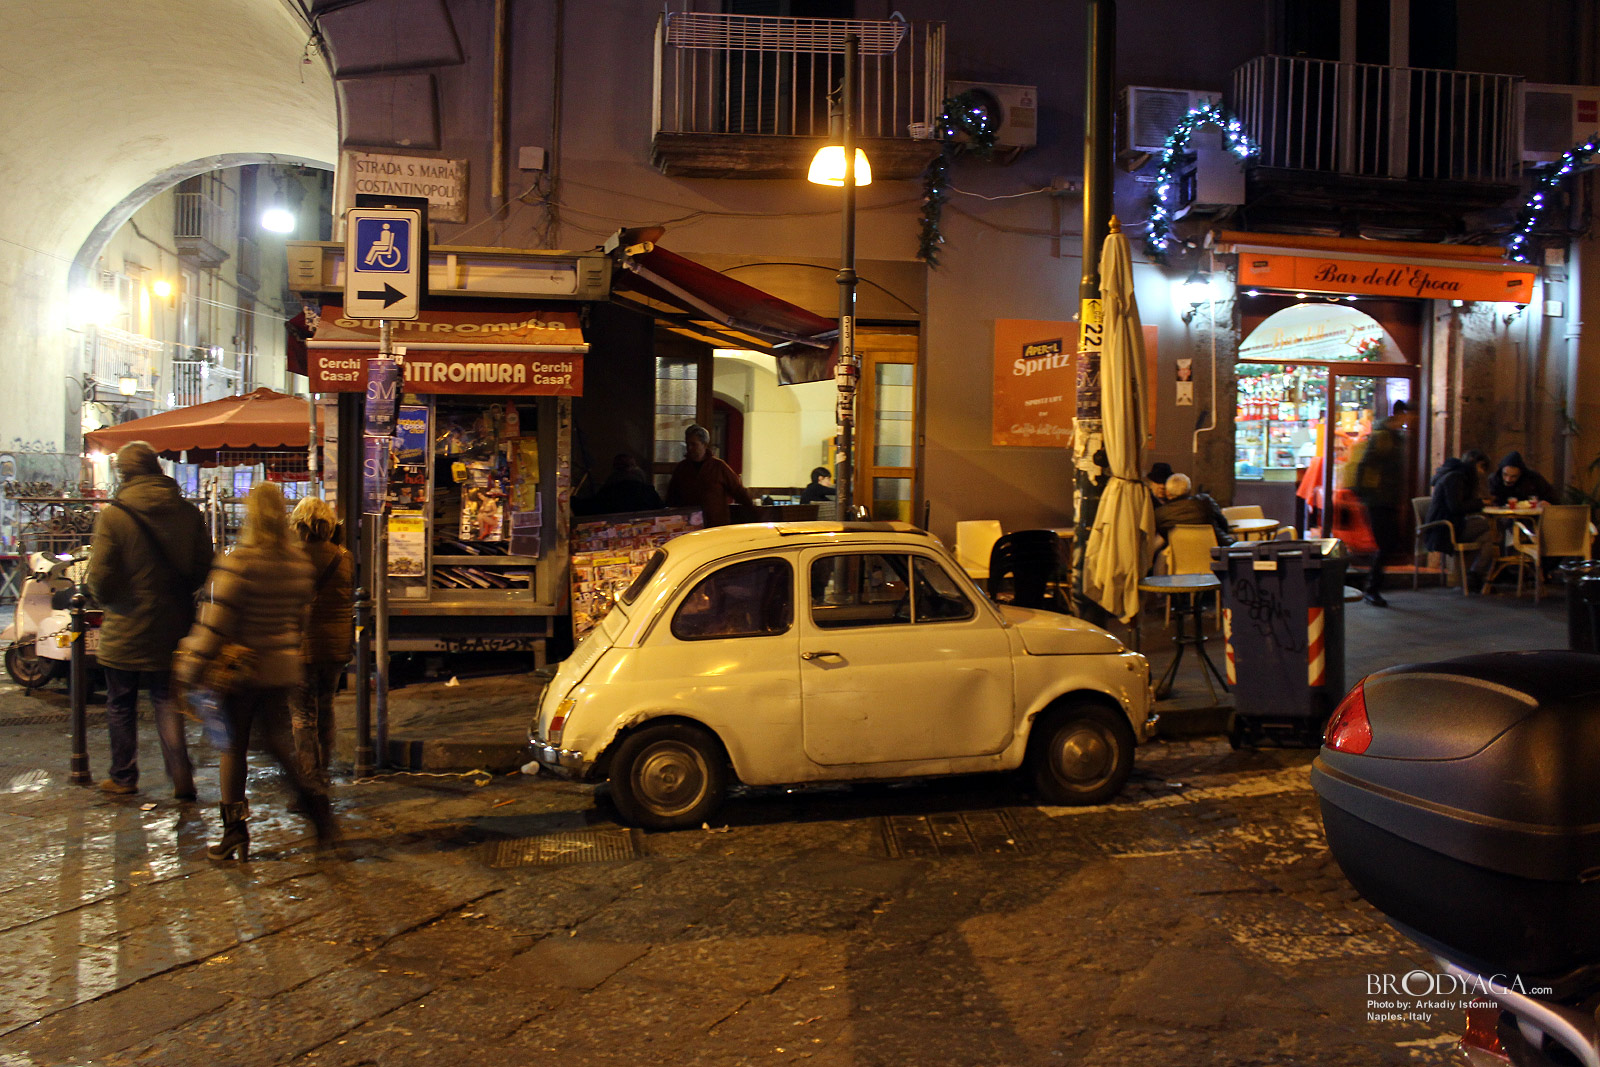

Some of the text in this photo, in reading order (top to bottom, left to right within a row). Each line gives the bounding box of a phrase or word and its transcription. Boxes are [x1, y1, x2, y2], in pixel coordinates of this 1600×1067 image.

[355, 160, 403, 176] STRADA
[420, 165, 457, 180] MARIA
[356, 179, 455, 198] COSTANTINOPOLI
[1314, 262, 1358, 283] Bar
[318, 357, 361, 370] Cerchi
[531, 361, 573, 374] Cerchi
[1013, 353, 1070, 376] Spritz
[320, 370, 360, 382] Casa?
[532, 374, 572, 386] Casa?
